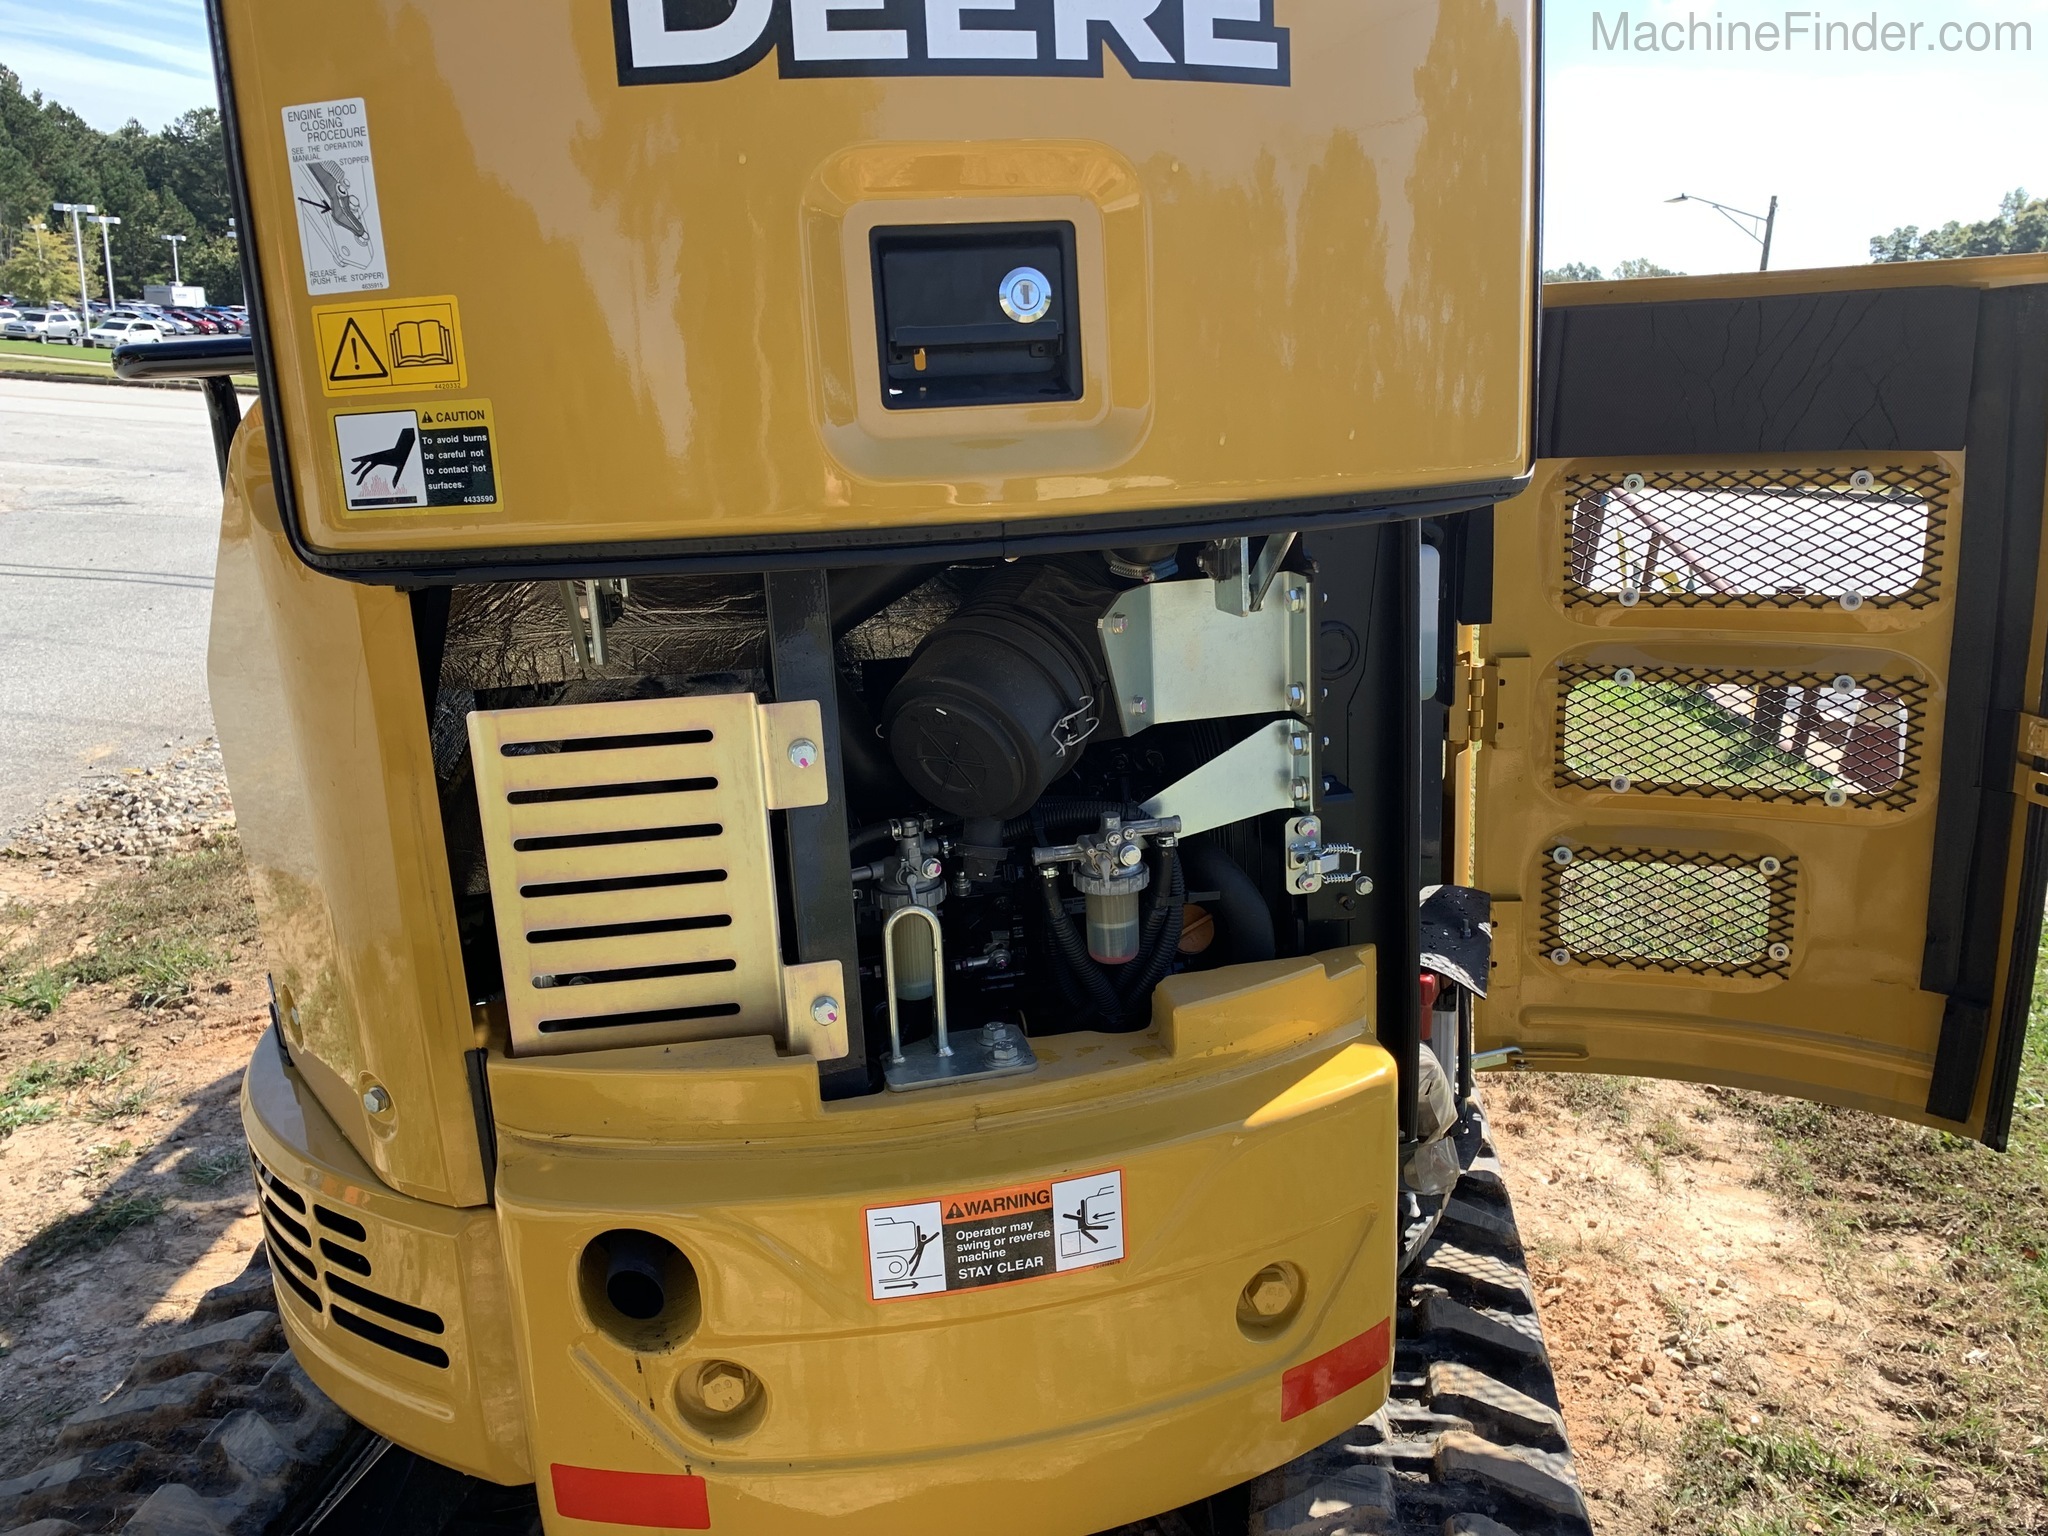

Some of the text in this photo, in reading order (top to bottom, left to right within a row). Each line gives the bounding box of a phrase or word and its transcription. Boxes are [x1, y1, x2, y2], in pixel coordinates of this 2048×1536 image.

[287, 104, 357, 122] ENGINE HOOD
[300, 117, 343, 132] CLOSING
[307, 126, 367, 143] PROCEDURE
[291, 140, 363, 155] SEE THE OPERATION
[292, 153, 321, 163] MANUAL
[339, 156, 370, 166] STOPPER
[310, 269, 336, 278] RELEASE
[310, 271, 385, 286] (PUSH THE STOPPER)
[436, 410, 485, 423] CAUTION
[422, 434, 488, 445] To avoid burns
[424, 449, 485, 460] be careful not
[425, 464, 487, 475] to contact hot
[427, 480, 465, 490] surfaces.
[463, 494, 494, 503] 4433590
[963, 1189, 1050, 1216] WARNING
[955, 1221, 1034, 1242] Operator may
[956, 1229, 1051, 1253] swing or reverse
[957, 1248, 1007, 1264] machine
[958, 1256, 1044, 1281] STAY CLEAR
